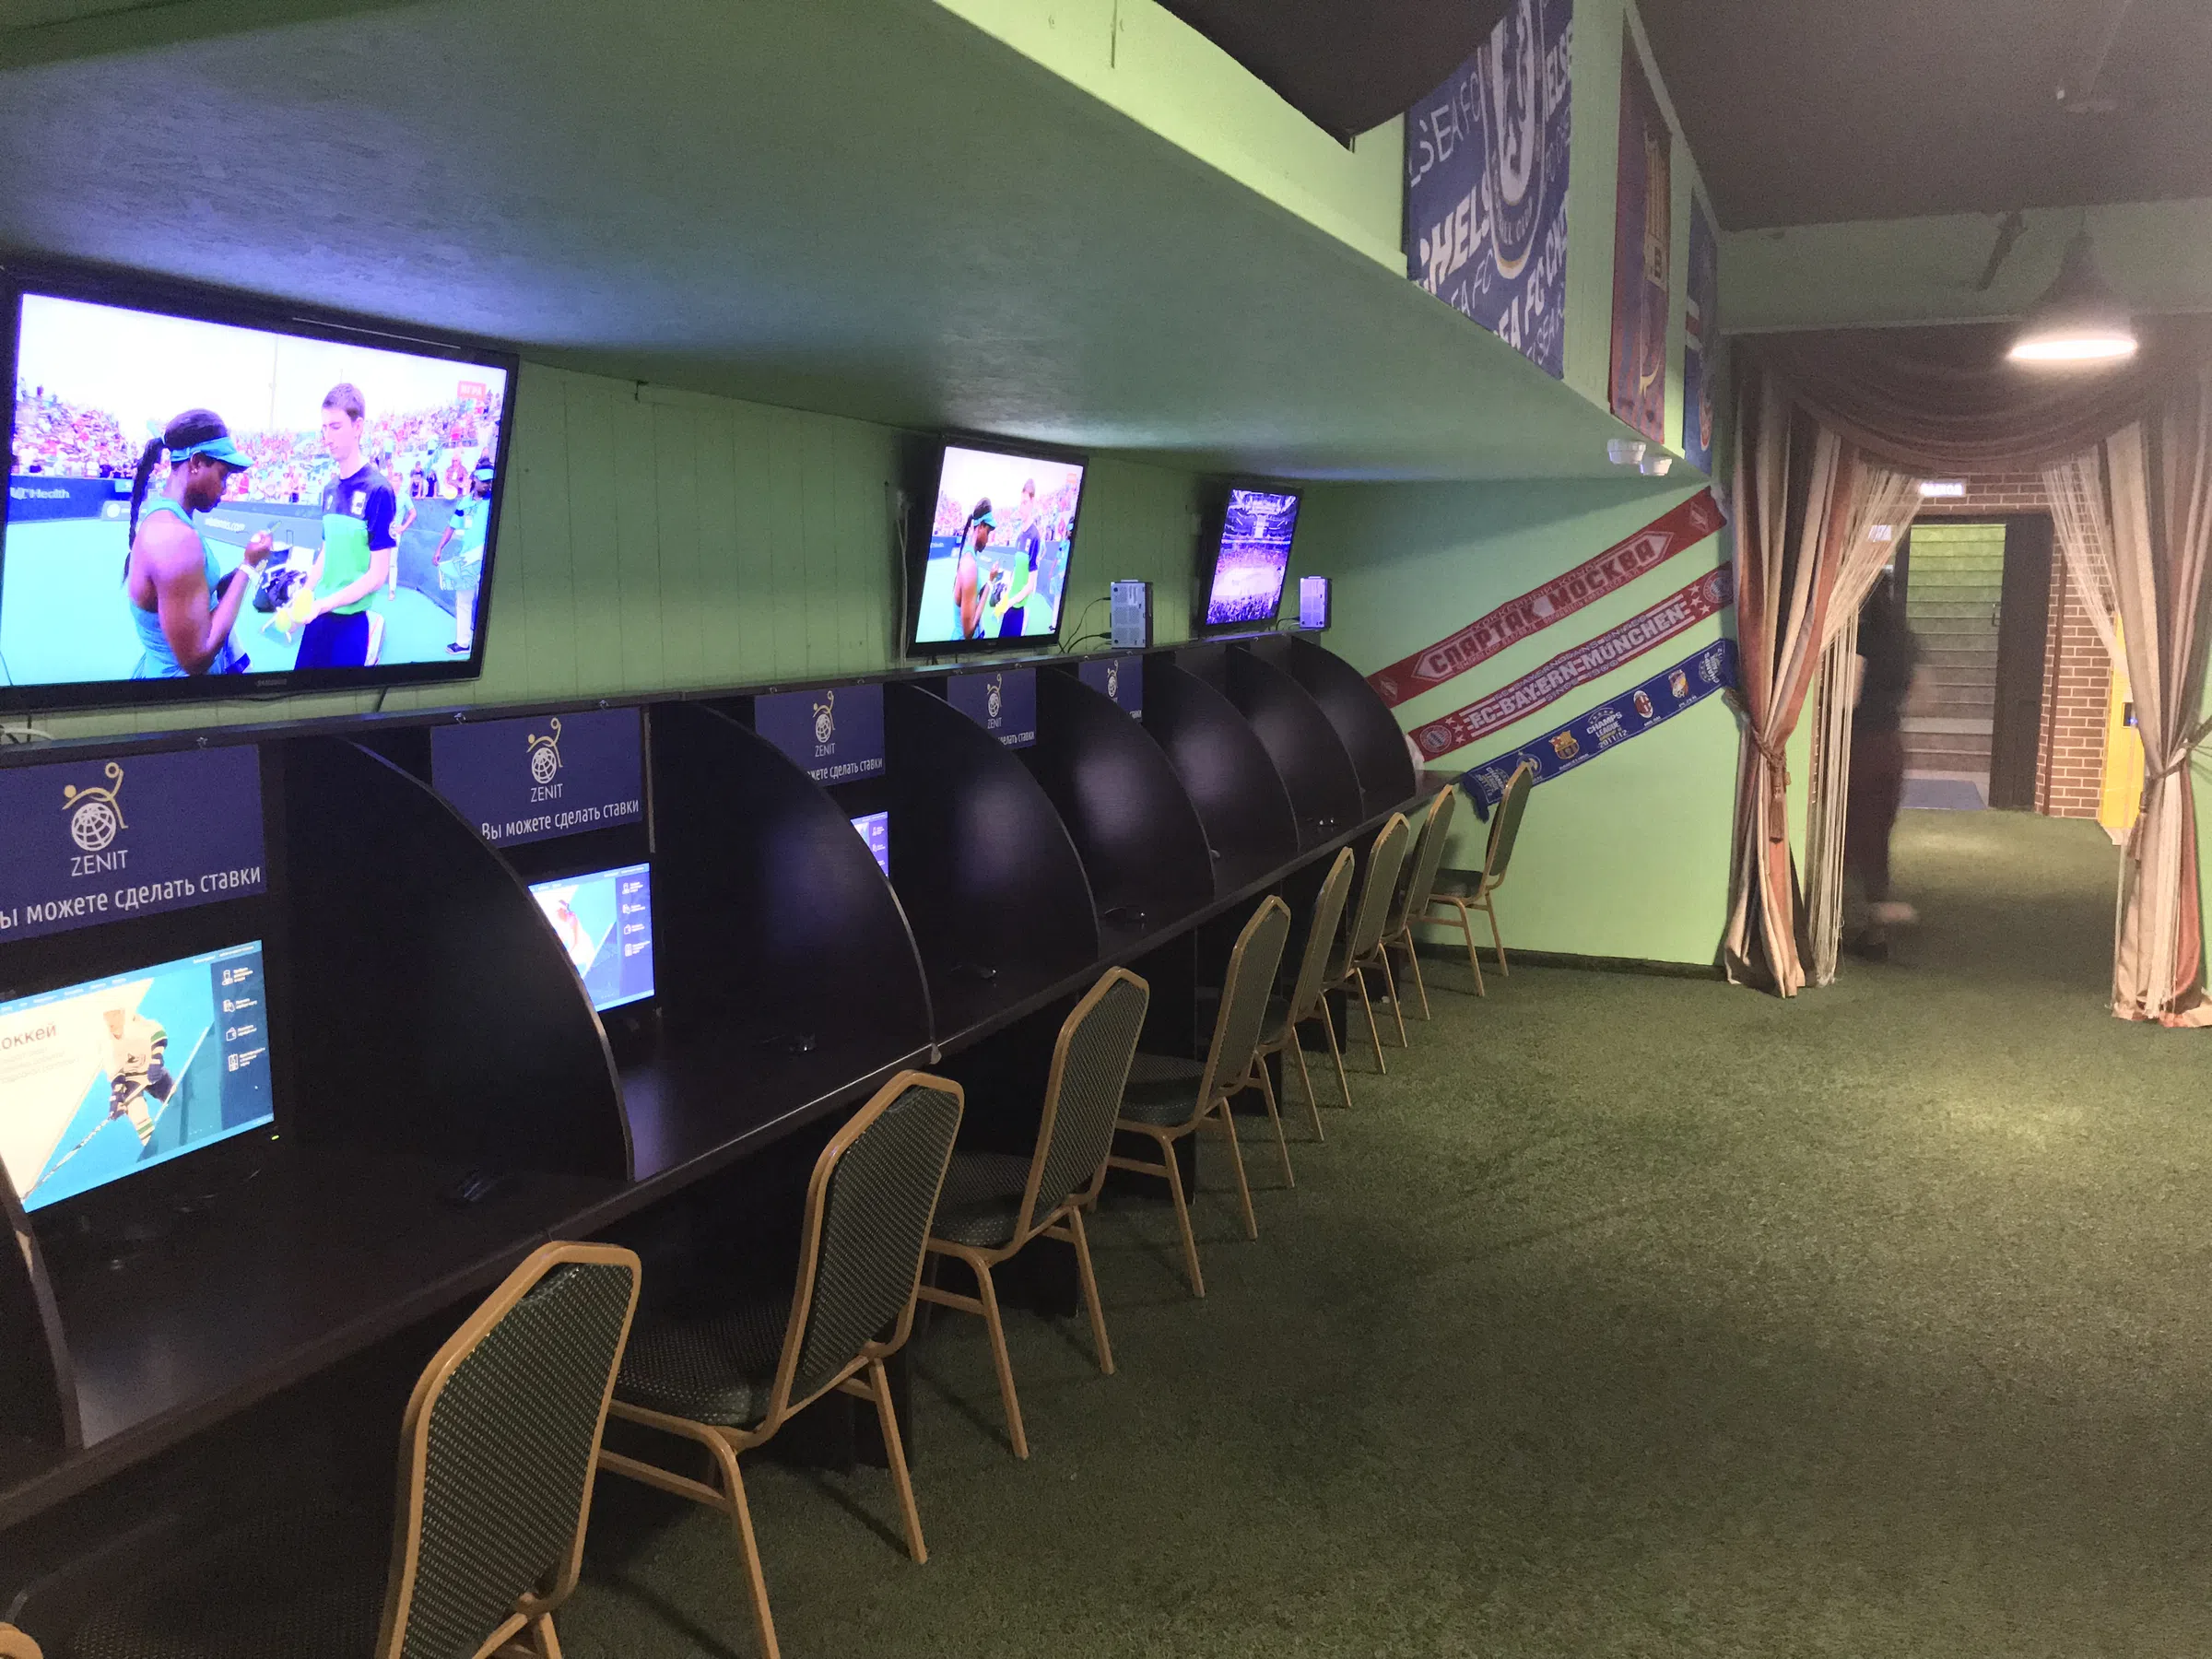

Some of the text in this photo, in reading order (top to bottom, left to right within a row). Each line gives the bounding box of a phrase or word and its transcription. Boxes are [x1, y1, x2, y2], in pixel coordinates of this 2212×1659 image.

[1524, 255, 1546, 337] FC
[1427, 537, 1655, 675] СПАРТАК МОСКВА
[1467, 703, 1498, 730] FC
[1498, 660, 1579, 715] BAYERN
[1586, 711, 1623, 735] CHAMPS
[1595, 721, 1620, 738] LEAGUE
[814, 742, 835, 758] ZENIT
[830, 761, 859, 780] сделать
[859, 758, 883, 772] ставки
[530, 782, 563, 803] ZENIT
[481, 799, 640, 841] Вы можете сделать ставки
[70, 849, 129, 877] ZENIT
[0, 865, 261, 930] ы можете сделать ставки
[0, 1021, 57, 1052] оккей
